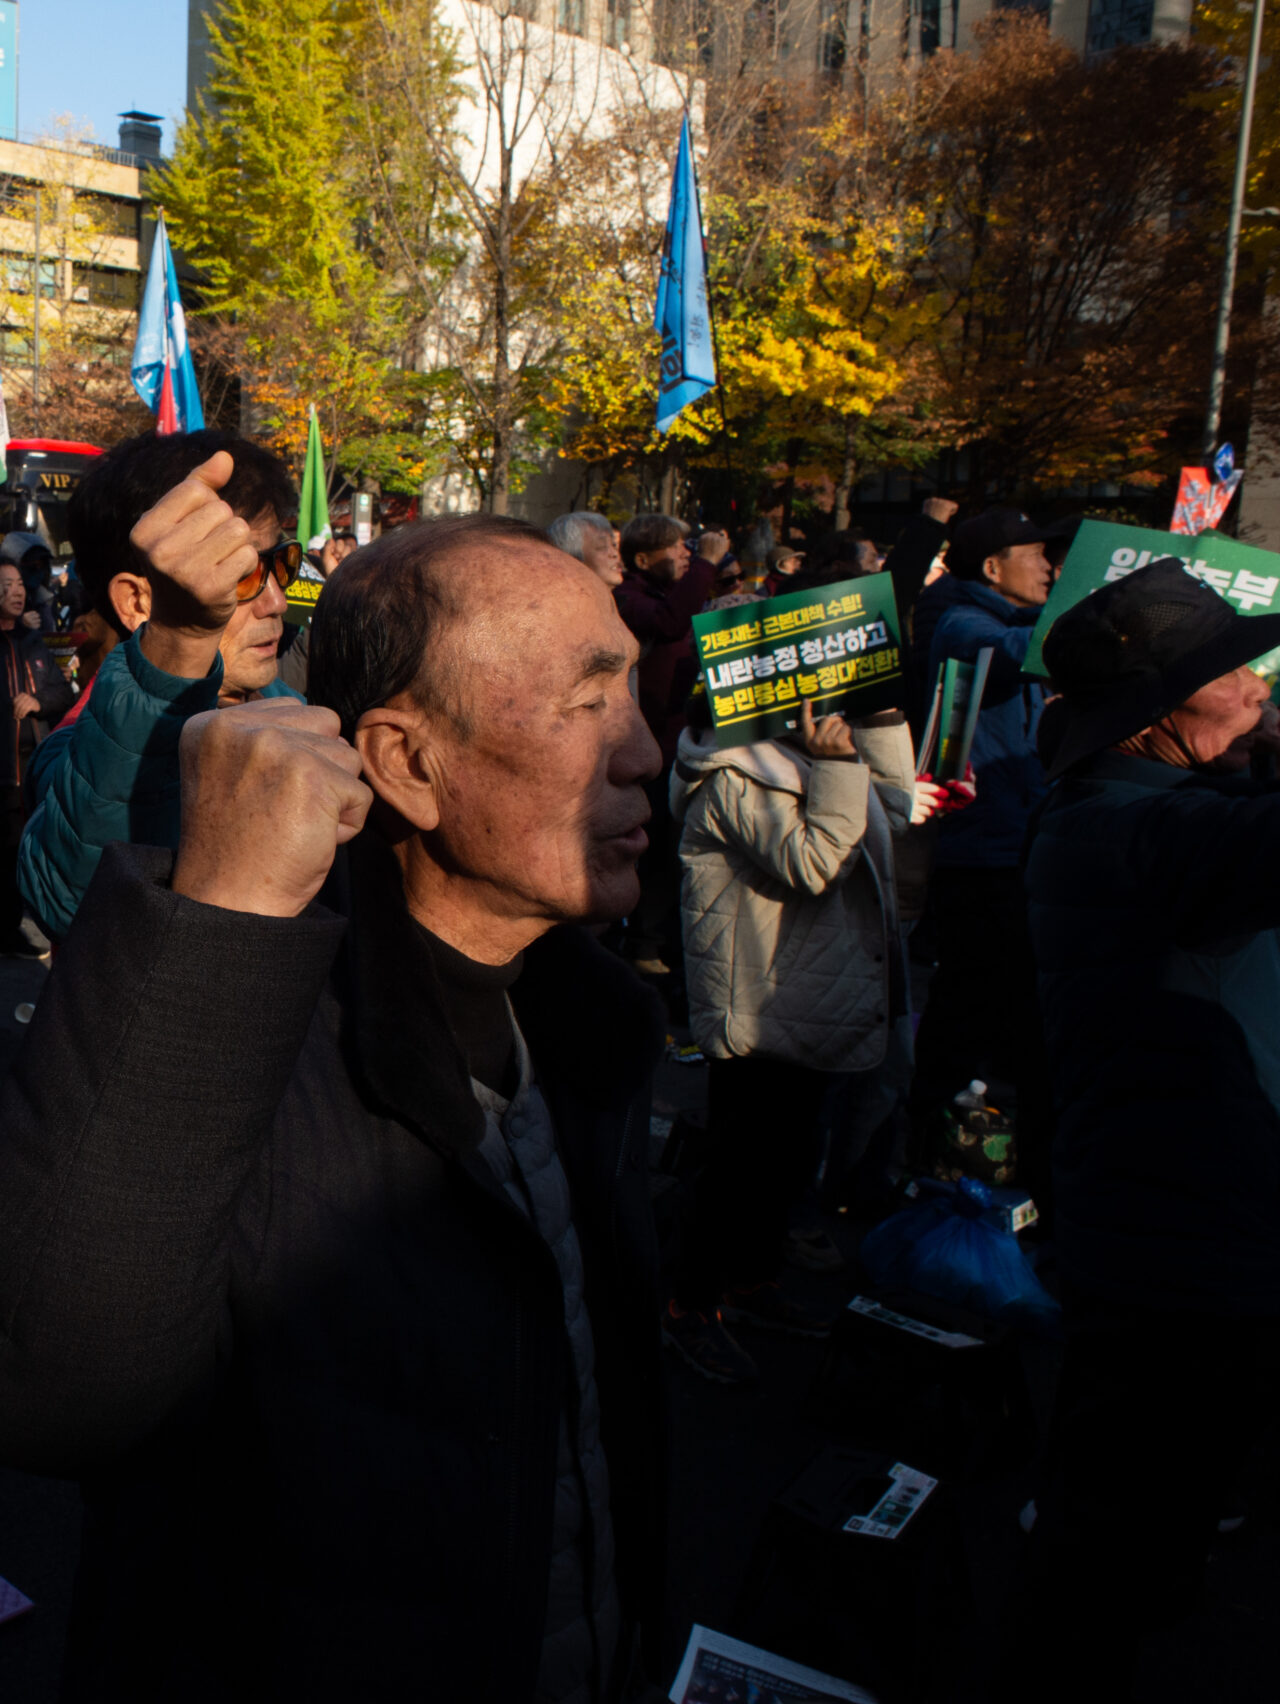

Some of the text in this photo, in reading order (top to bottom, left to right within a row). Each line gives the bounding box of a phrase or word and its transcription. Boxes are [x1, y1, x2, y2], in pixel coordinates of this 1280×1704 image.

[40, 473, 70, 488] VIP
[700, 593, 863, 652] 기후재난 근본대책 수립!
[706, 620, 888, 690] 내란농정 청산하고
[713, 648, 900, 717] 농민중심 농정대전환!
